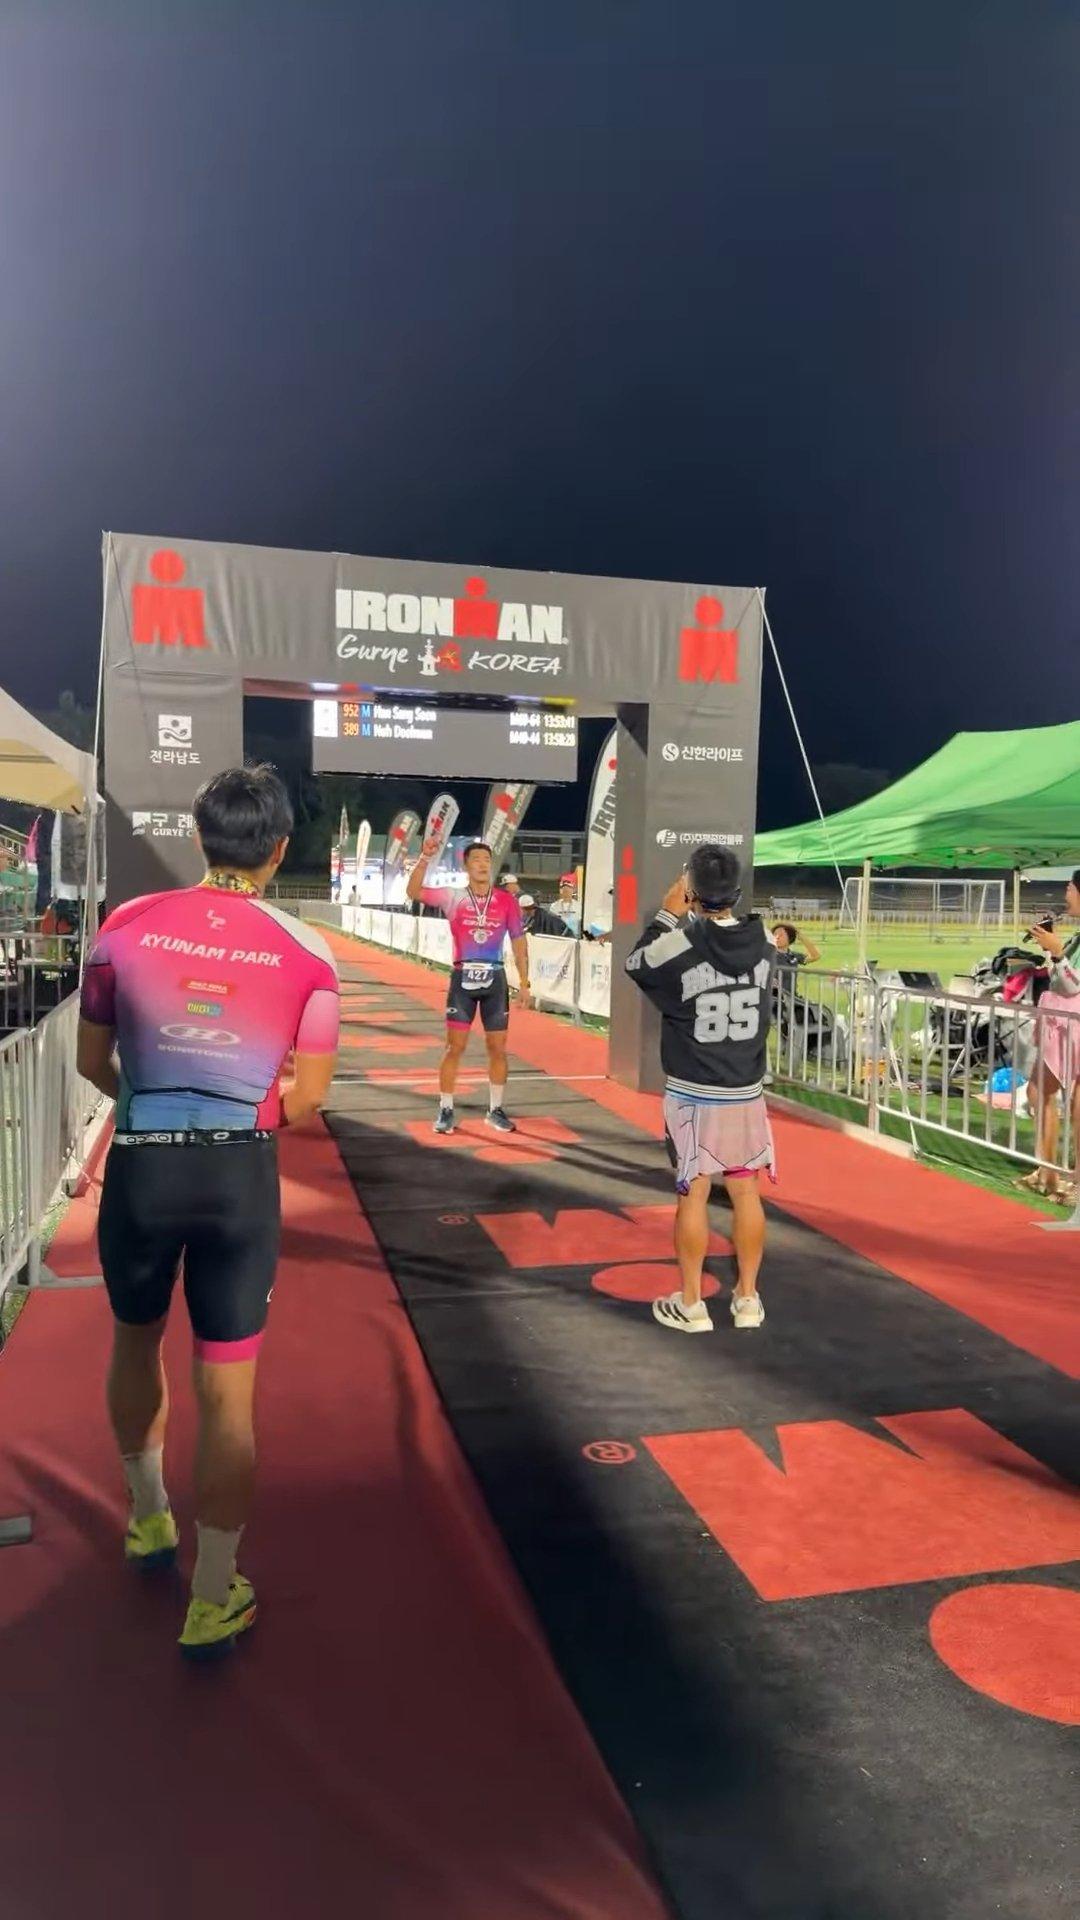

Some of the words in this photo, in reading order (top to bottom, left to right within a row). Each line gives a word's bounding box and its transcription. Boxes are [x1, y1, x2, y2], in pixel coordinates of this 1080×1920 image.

[336, 634, 409, 673] Gurye
[468, 651, 562, 675] KOREA
[342, 703, 359, 718] 952
[361, 704, 371, 718] M
[342, 722, 359, 736] 389
[361, 723, 371, 736] M
[149, 749, 202, 766] 전라남도
[681, 745, 744, 762] 신한라이프
[152, 827, 184, 837] GURYE
[139, 931, 227, 961] KYUNAM
[229, 948, 284, 968] PARK
[467, 969, 489, 980] 427
[693, 986, 761, 1044] 85
